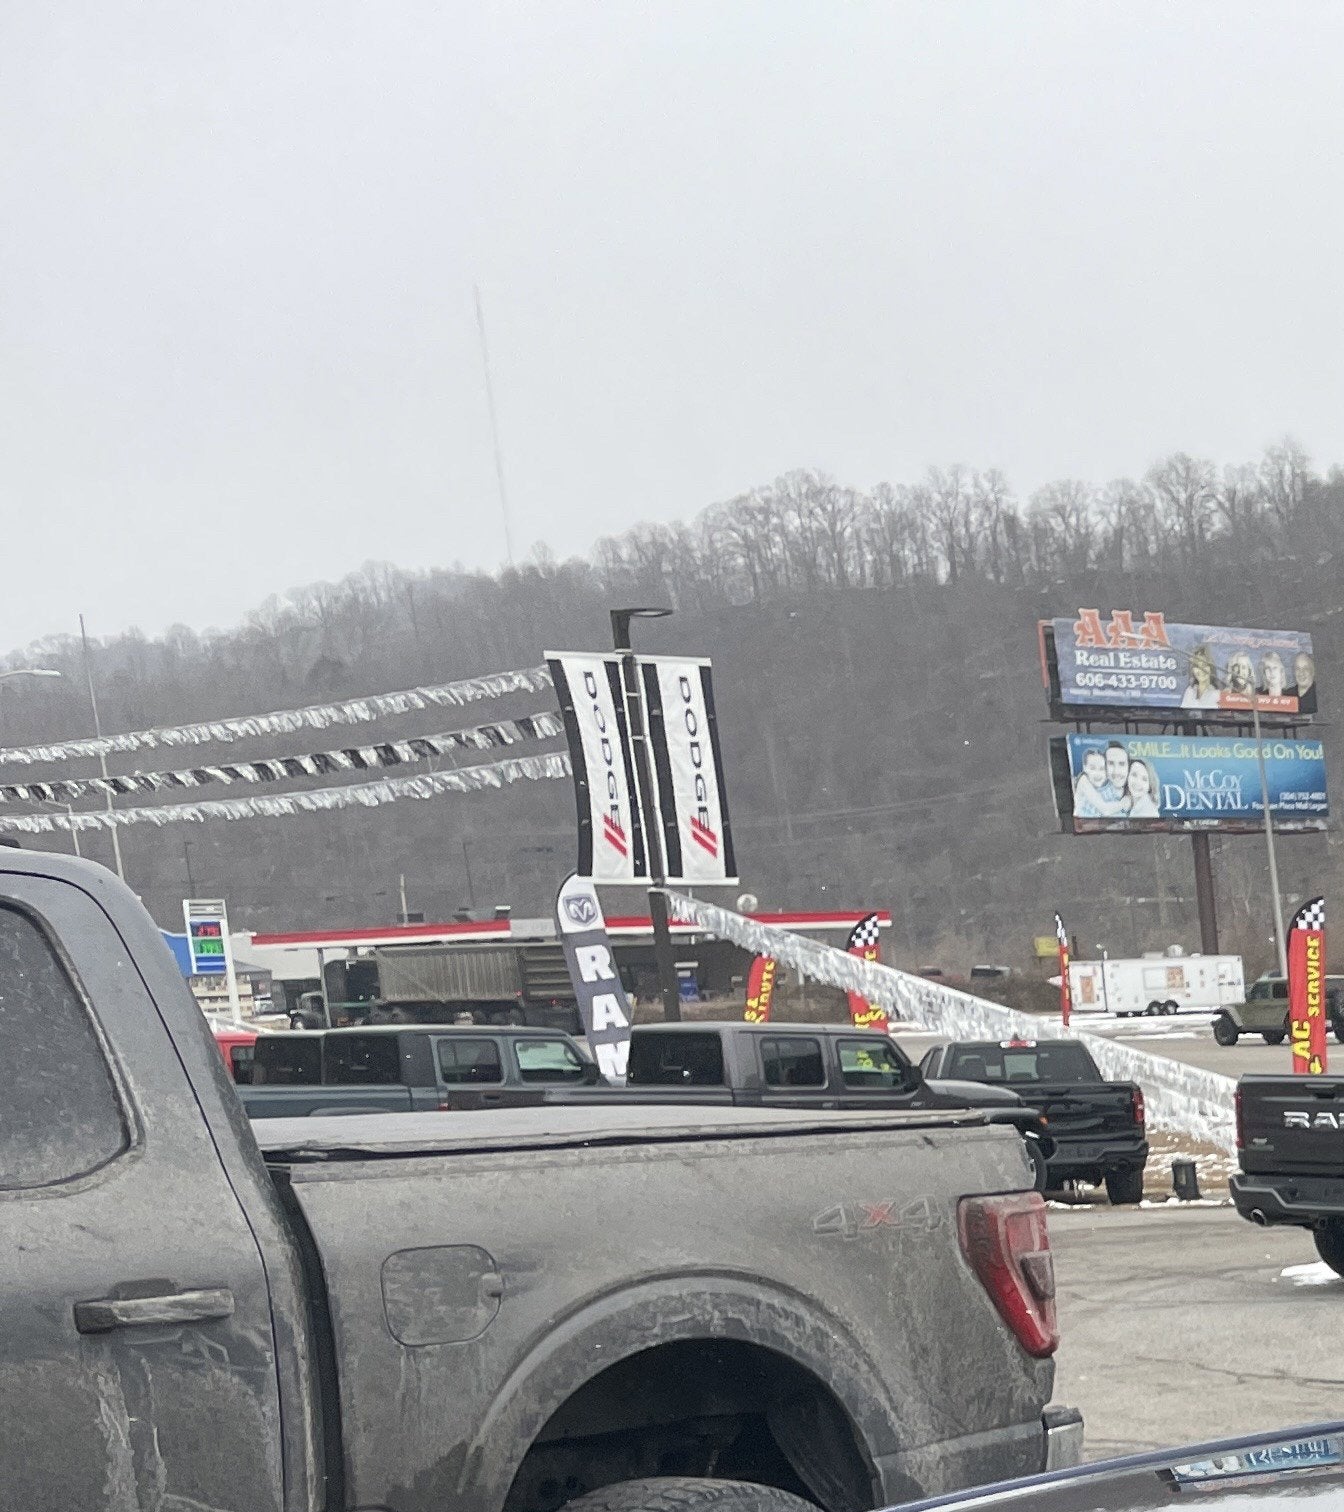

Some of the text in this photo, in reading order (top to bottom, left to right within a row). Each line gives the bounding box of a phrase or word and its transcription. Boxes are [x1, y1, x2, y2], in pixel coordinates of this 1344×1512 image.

[1074, 650, 1178, 670] Real Estate
[583, 672, 621, 830] DODGE
[679, 676, 710, 832] DODGE
[1191, 744, 1232, 758] Looks
[1274, 744, 1295, 760] On
[1295, 743, 1324, 760] You!
[1307, 935, 1321, 1018] SERVICE
[1291, 1020, 1311, 1060] AC
